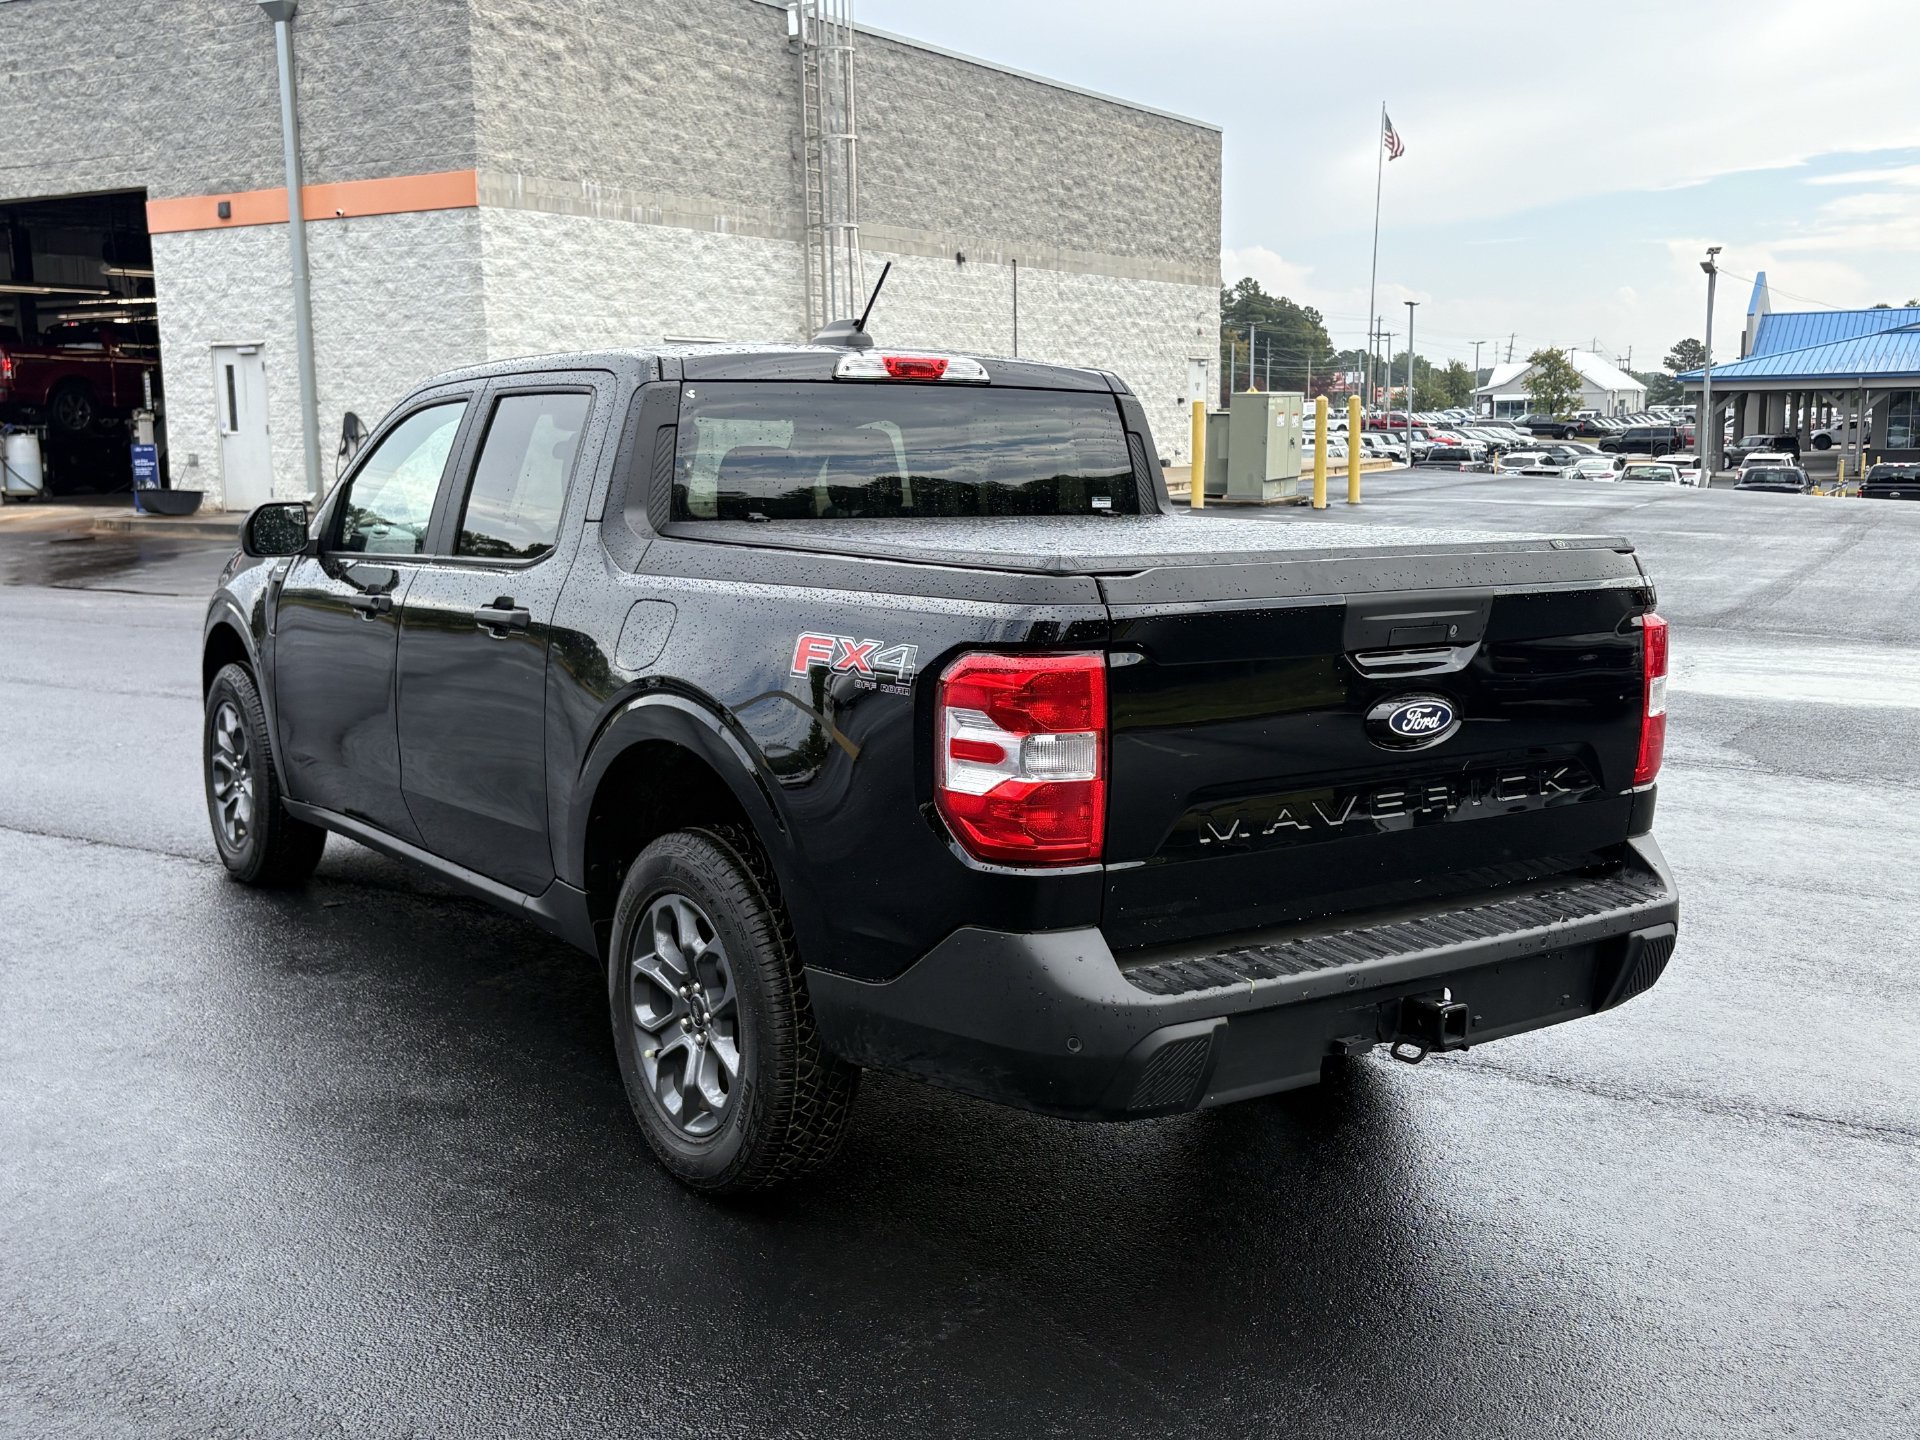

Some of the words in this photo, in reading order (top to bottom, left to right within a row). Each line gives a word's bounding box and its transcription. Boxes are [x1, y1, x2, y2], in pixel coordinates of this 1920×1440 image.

[789, 630, 919, 686] FX4
[854, 679, 878, 691] OFF
[1401, 706, 1442, 732] Ford
[1198, 766, 1572, 844] MAVERICK
